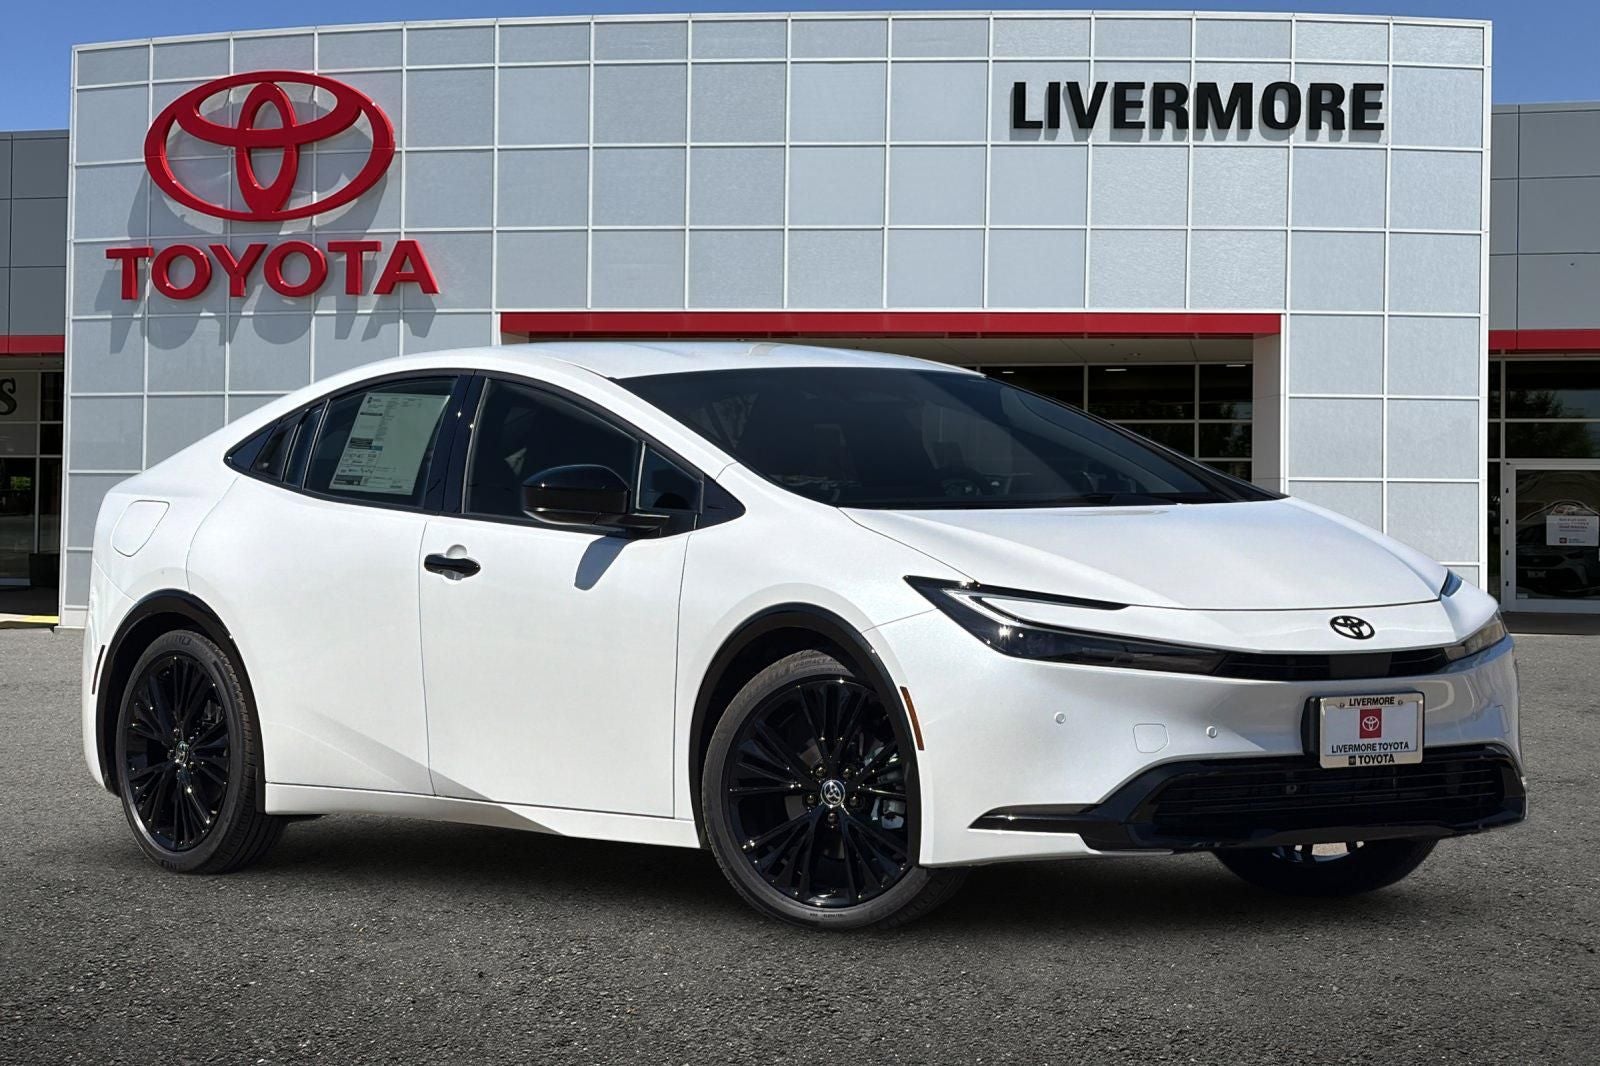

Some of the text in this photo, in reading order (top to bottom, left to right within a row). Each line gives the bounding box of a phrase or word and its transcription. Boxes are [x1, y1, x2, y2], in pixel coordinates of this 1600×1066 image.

[1013, 81, 1385, 131] LIVERMORE
[105, 240, 440, 300] TOYOTA
[1349, 697, 1394, 707] LIVERMORE
[1331, 742, 1409, 754] LIVERMORE TOYOTA
[1358, 754, 1395, 764] TOYOTA
